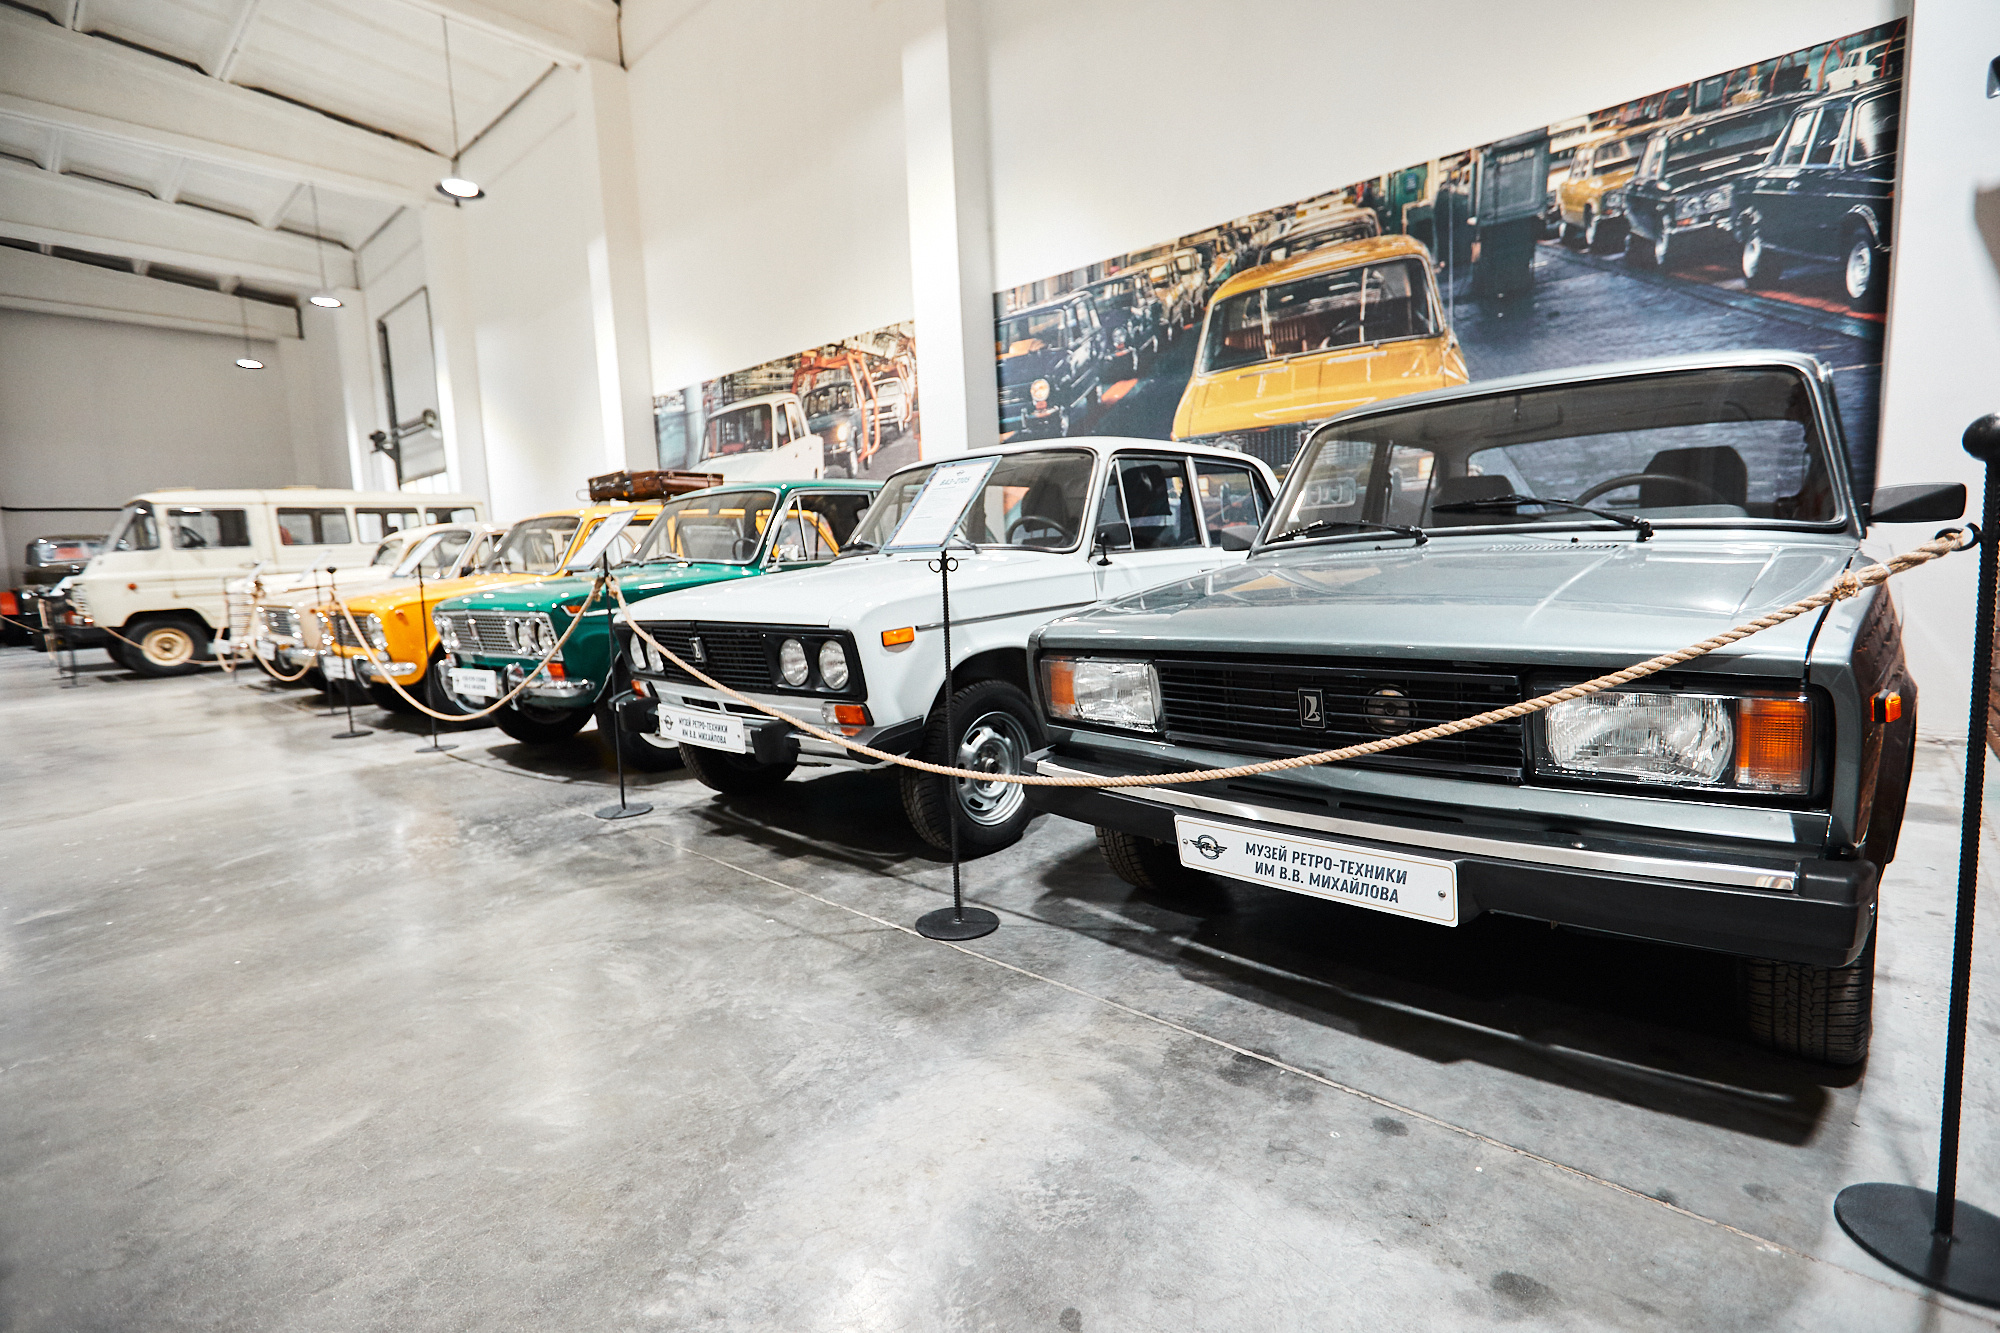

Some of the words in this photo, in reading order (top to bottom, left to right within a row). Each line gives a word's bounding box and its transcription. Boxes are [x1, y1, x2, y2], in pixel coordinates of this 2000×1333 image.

[1245, 841, 1287, 862] МУЗЕЙ
[1291, 851, 1408, 885] РЕТРО-ТЕХНИКИ
[1255, 862, 1275, 877] ИМ
[1279, 867, 1303, 884] В.В.
[1309, 872, 1399, 904] МИХАЙЛОВА
